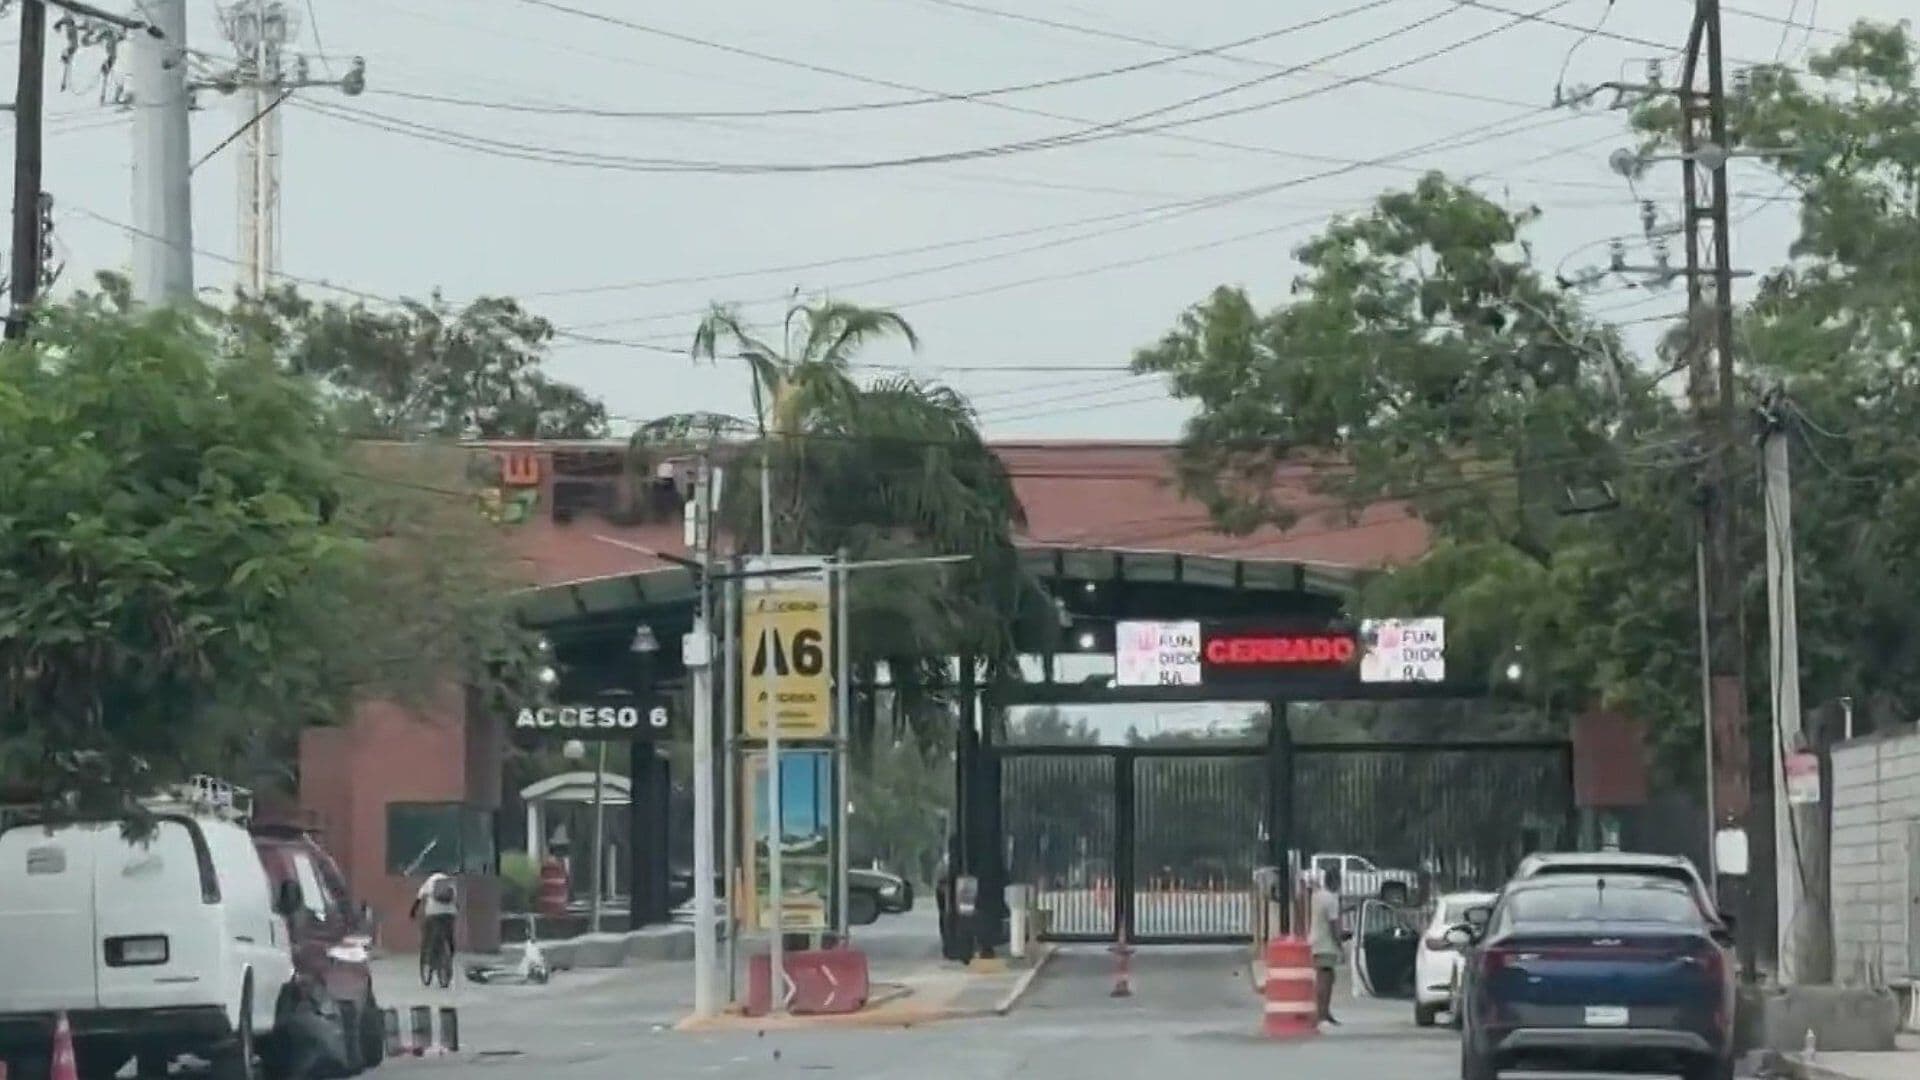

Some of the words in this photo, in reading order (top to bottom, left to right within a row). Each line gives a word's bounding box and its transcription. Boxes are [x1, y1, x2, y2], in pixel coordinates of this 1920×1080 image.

[1403, 630, 1437, 643] FUN
[1403, 647, 1441, 662] DIDO
[516, 707, 638, 728] ACCESO
[649, 708, 668, 727] 6
